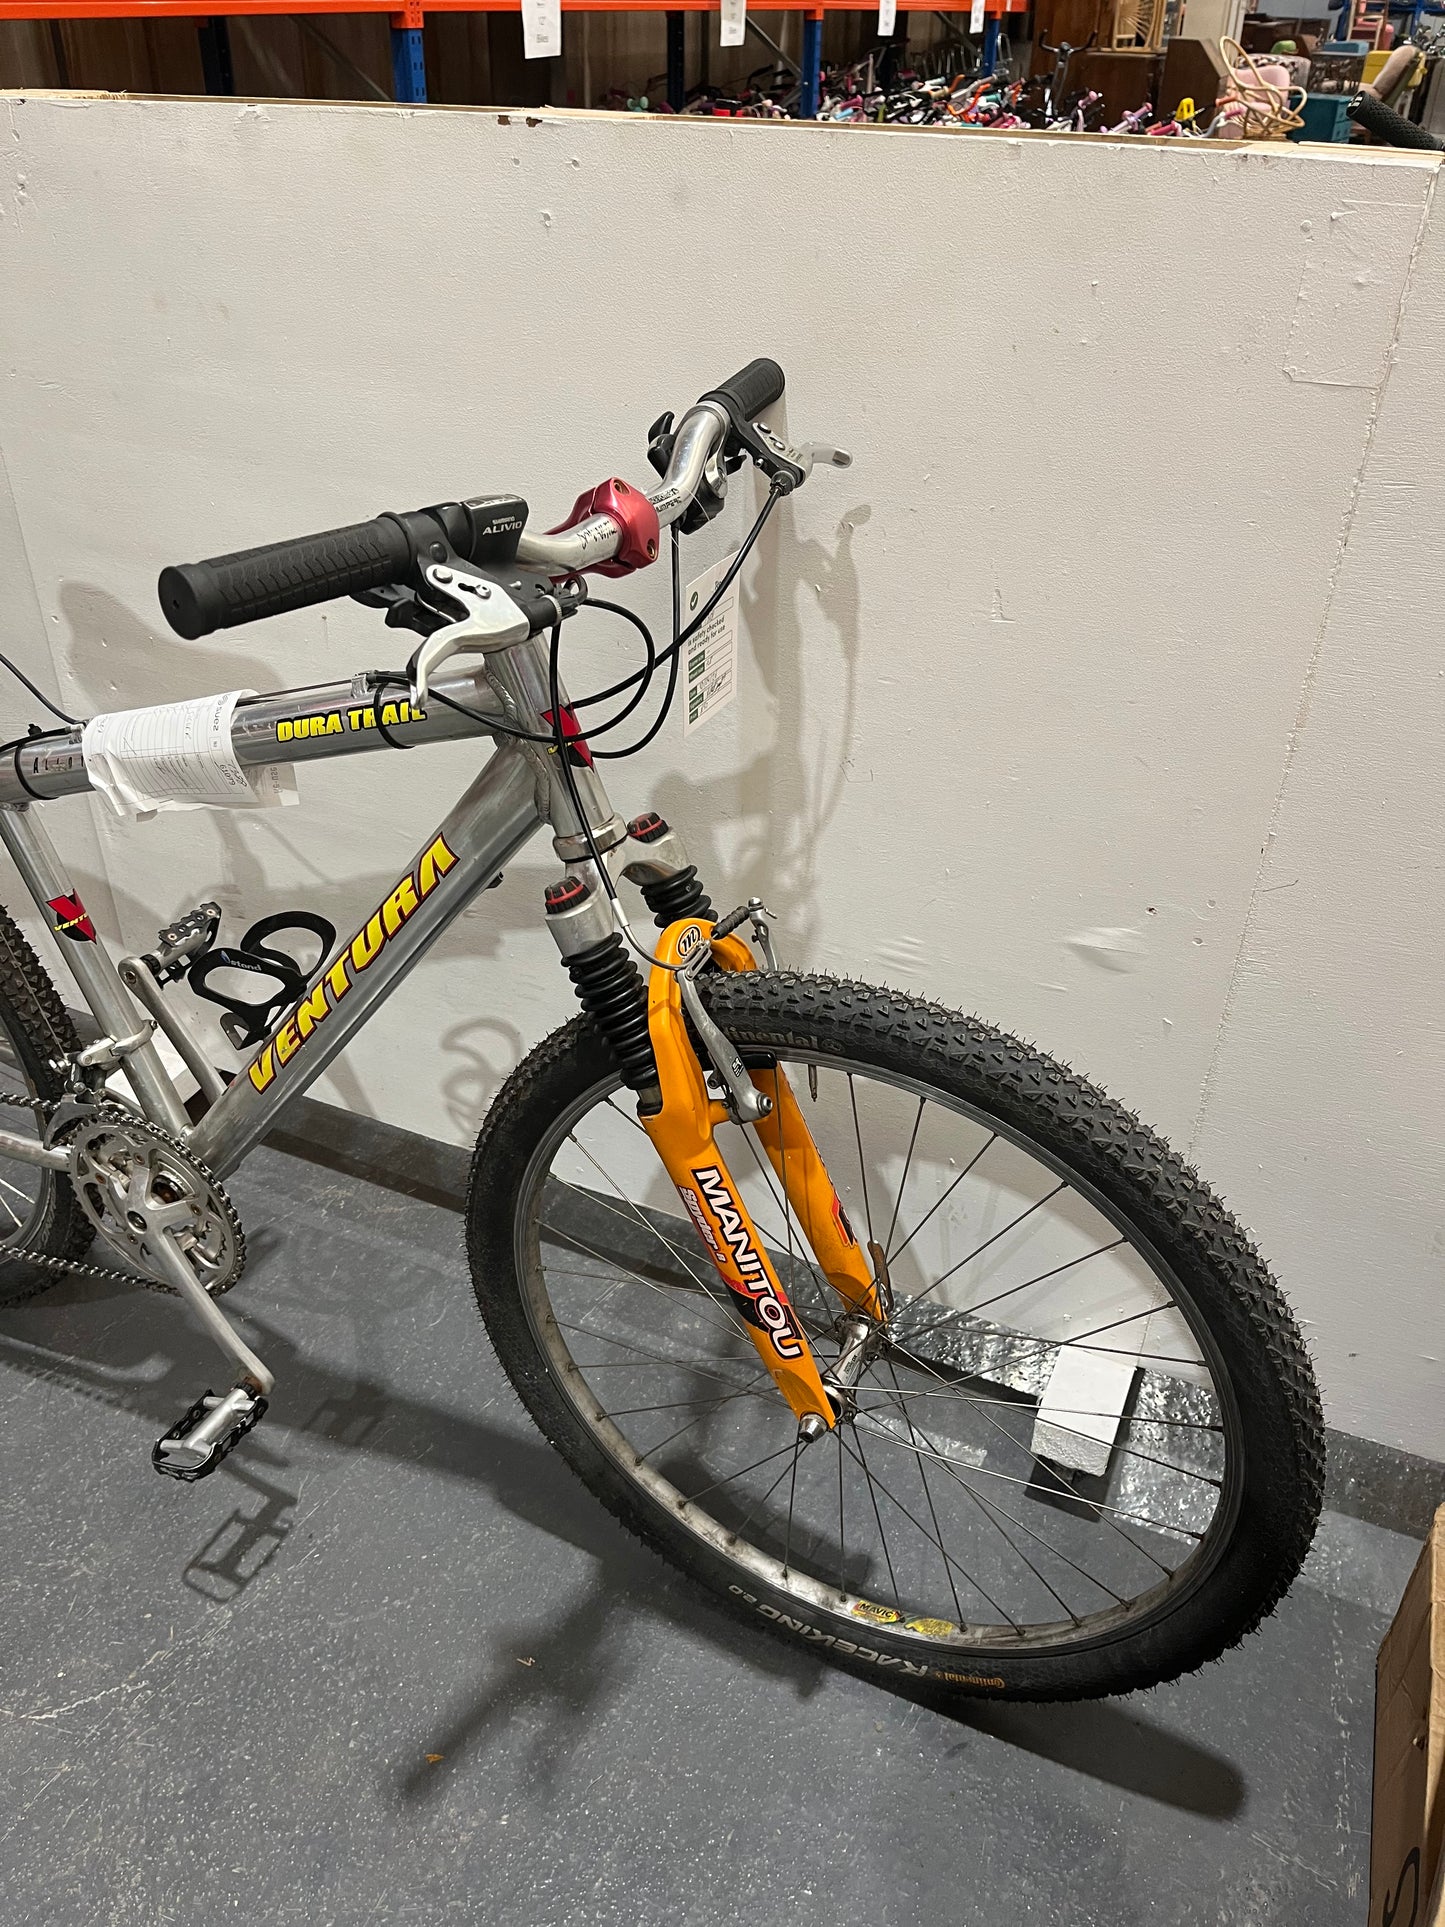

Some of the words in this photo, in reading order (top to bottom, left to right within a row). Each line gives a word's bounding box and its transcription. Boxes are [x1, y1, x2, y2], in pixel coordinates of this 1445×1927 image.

[482, 521, 523, 536] ALIVIO
[707, 614, 725, 633] checked
[697, 635, 710, 649] ready
[276, 711, 344, 743] DURA
[248, 832, 461, 1095] VENTURA
[679, 1185, 718, 1251] Spyder
[693, 1165, 802, 1360] MANITOU
[858, 1602, 894, 1618] MAVIC
[943, 1671, 1006, 1689] Continental
